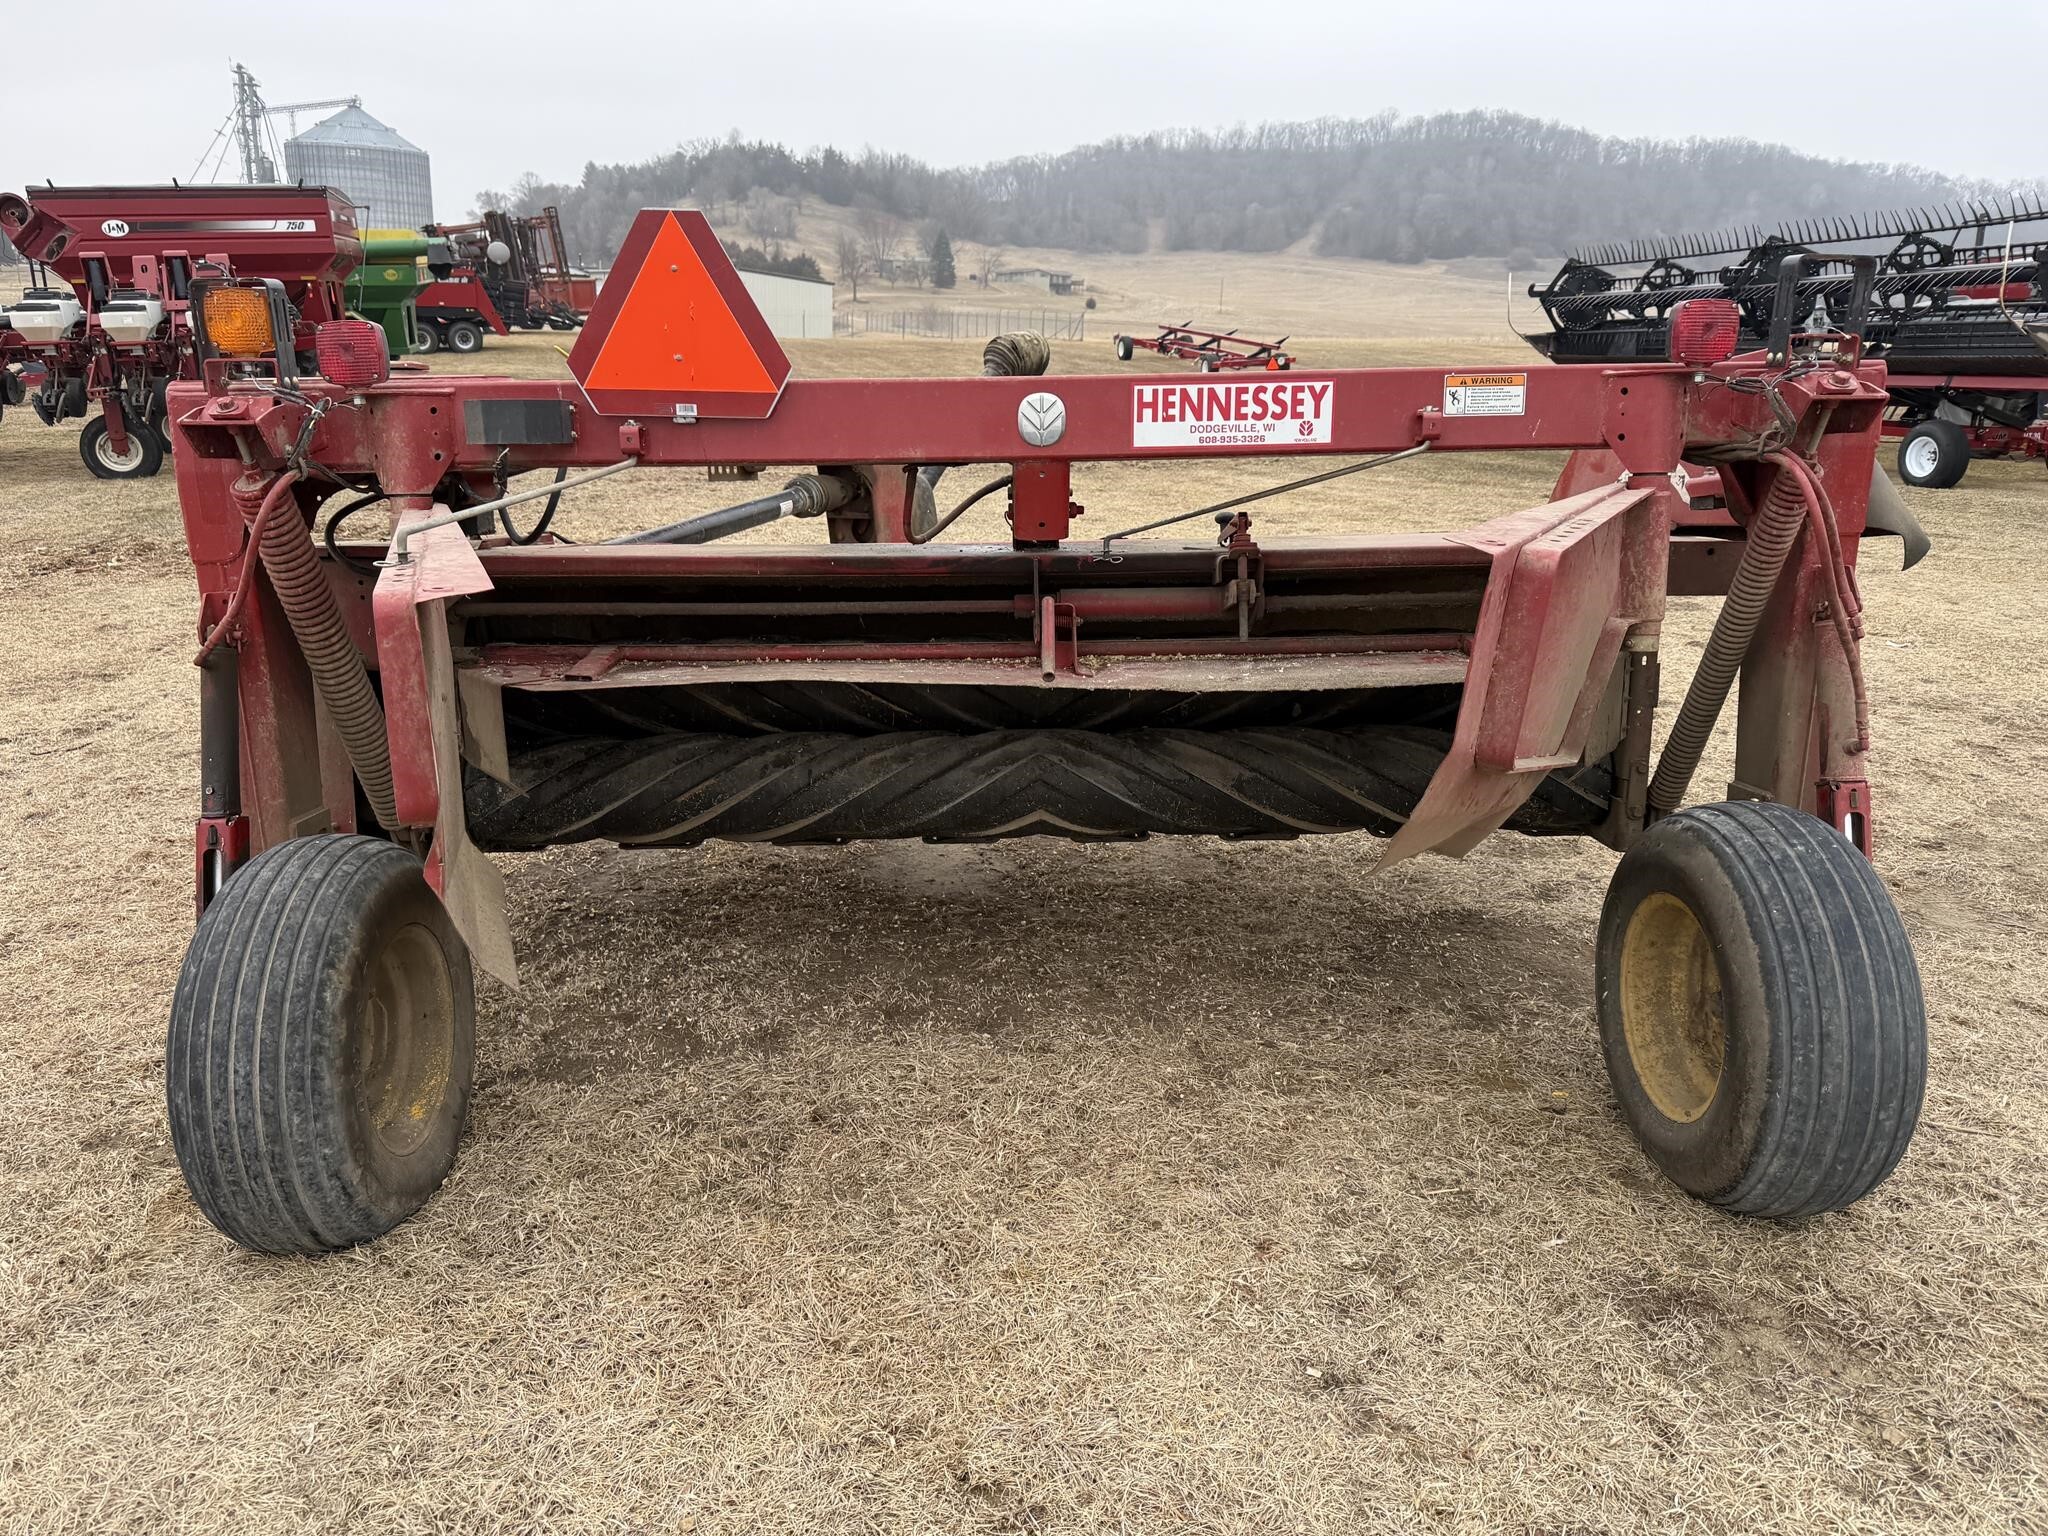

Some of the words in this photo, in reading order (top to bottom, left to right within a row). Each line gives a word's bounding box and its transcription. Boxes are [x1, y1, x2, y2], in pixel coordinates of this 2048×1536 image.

[104, 223, 125, 234] J&M
[286, 221, 305, 230] 750
[1471, 377, 1513, 385] WARNING
[1136, 385, 1330, 422] HENNESSEY
[1189, 424, 1260, 434] DODGEVILLE,
[1263, 423, 1276, 432] WI
[1198, 434, 1266, 444] 608-935-3326
